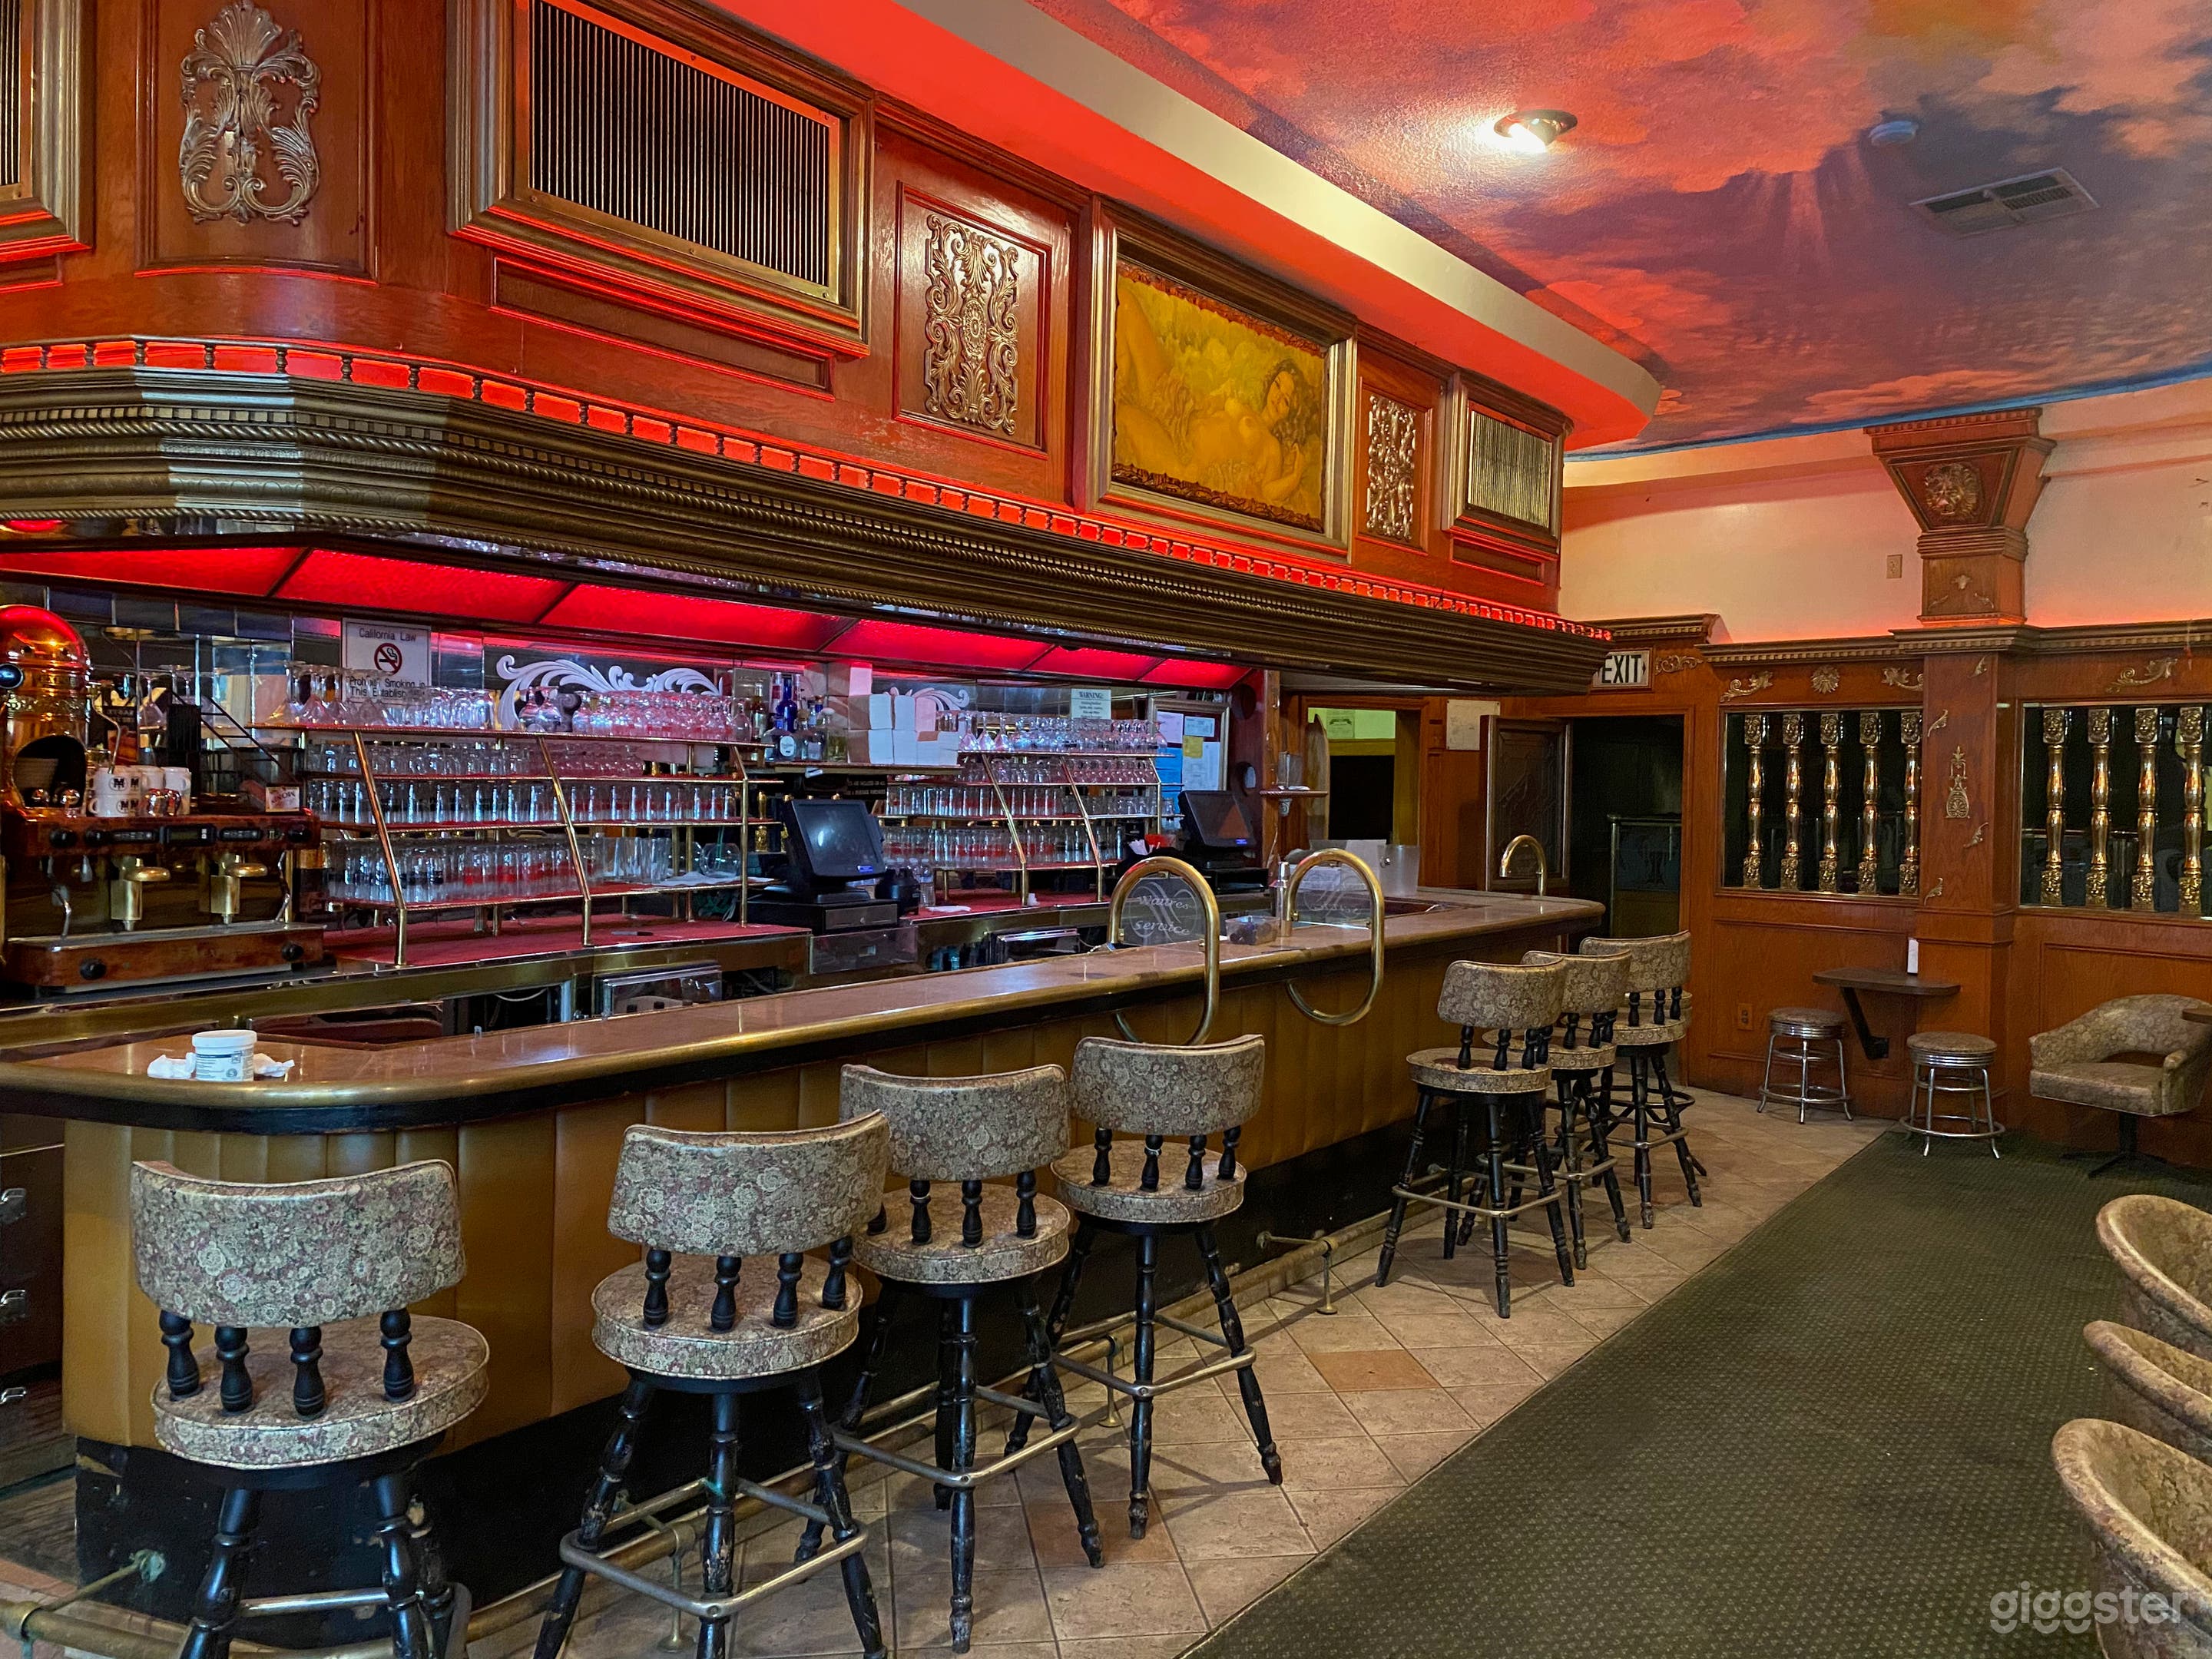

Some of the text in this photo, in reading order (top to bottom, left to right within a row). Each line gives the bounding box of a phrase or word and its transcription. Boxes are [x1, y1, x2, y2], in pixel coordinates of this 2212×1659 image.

[359, 628, 416, 641] California Law
[1601, 654, 1642, 684] EXIT
